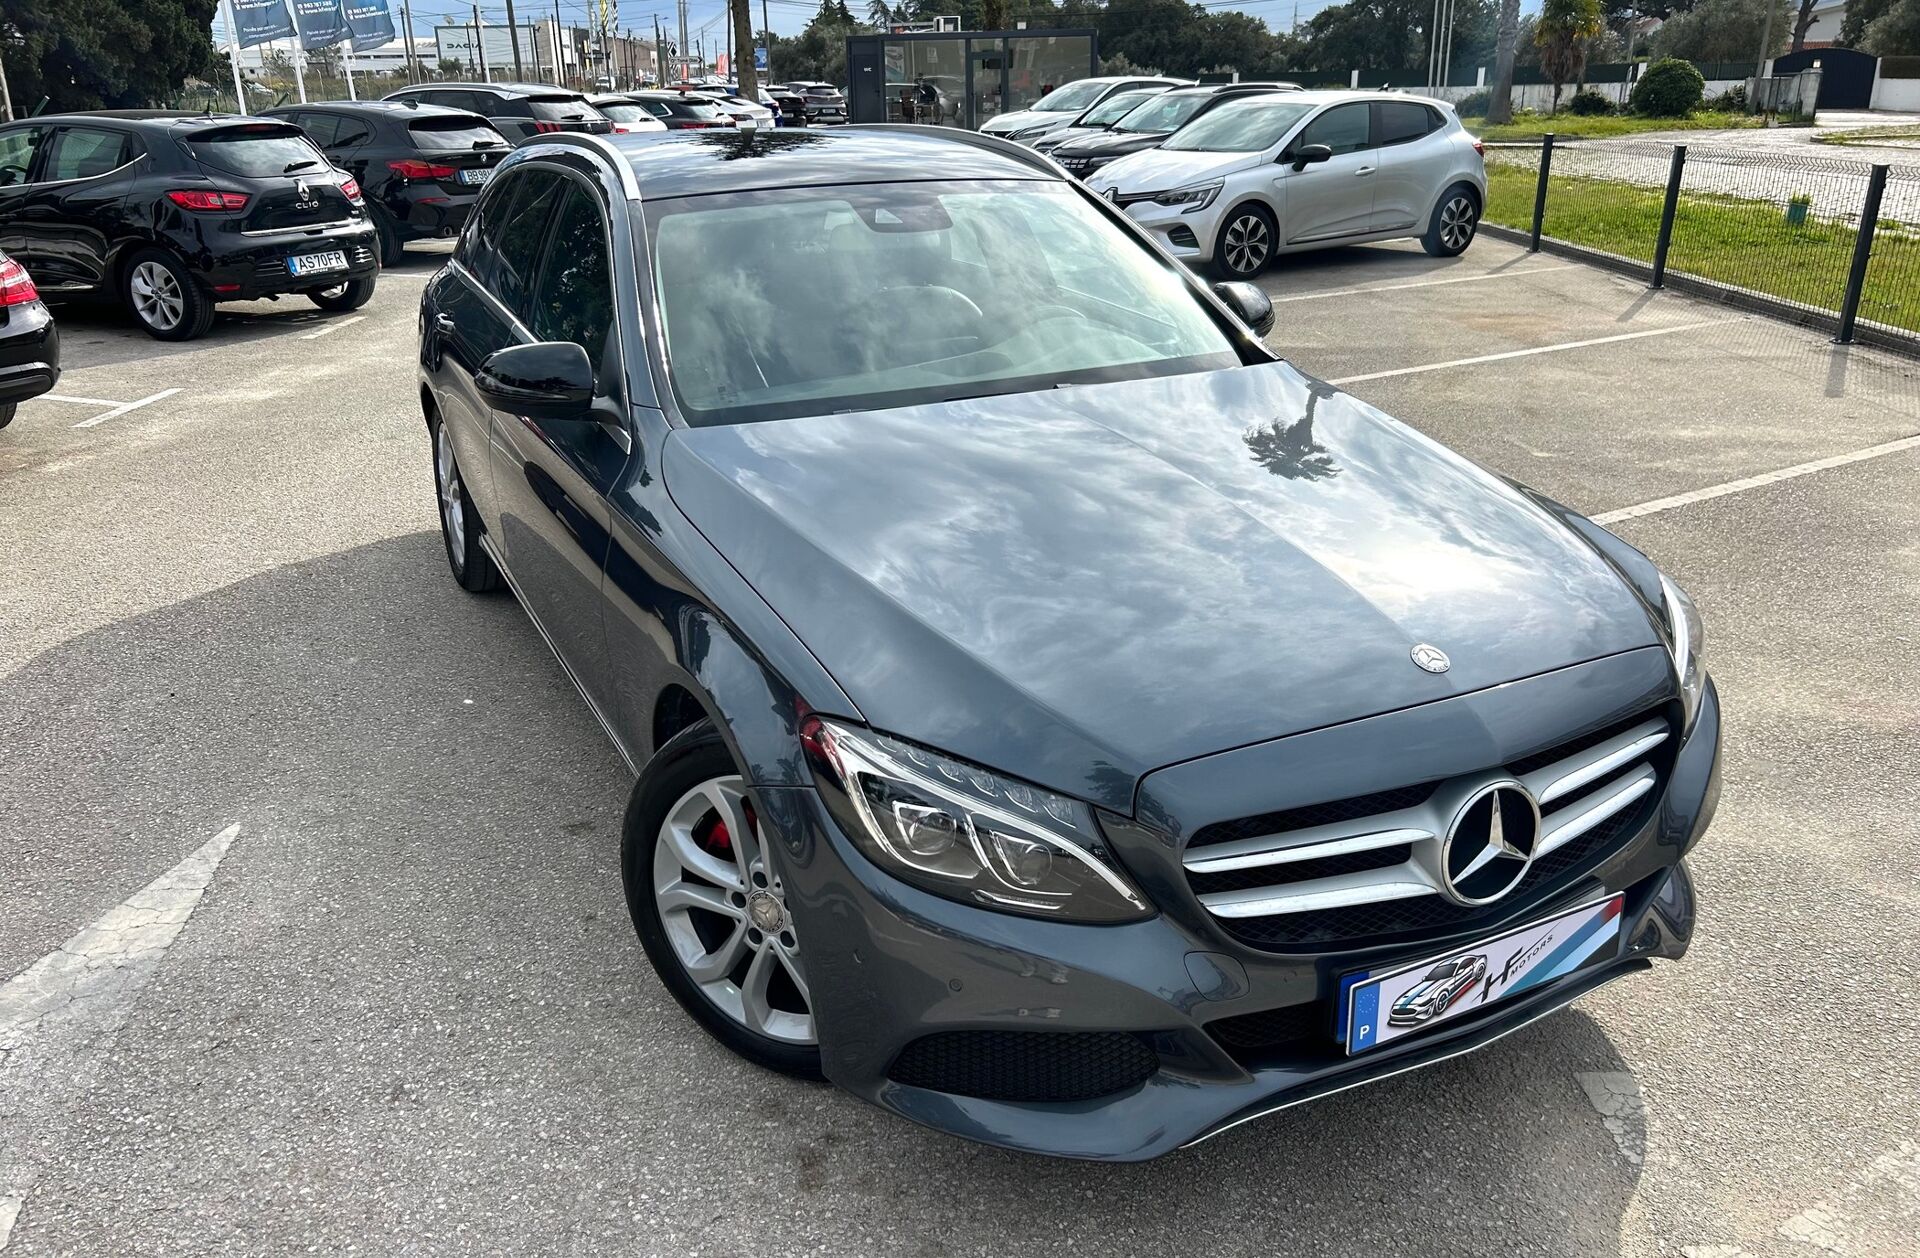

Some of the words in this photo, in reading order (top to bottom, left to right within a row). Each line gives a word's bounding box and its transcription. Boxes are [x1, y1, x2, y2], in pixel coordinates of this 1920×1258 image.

[295, 200, 319, 209] CLIO
[299, 252, 343, 270] AS70FR
[1510, 934, 1553, 977] MOTORS
[1359, 1024, 1370, 1039] P
